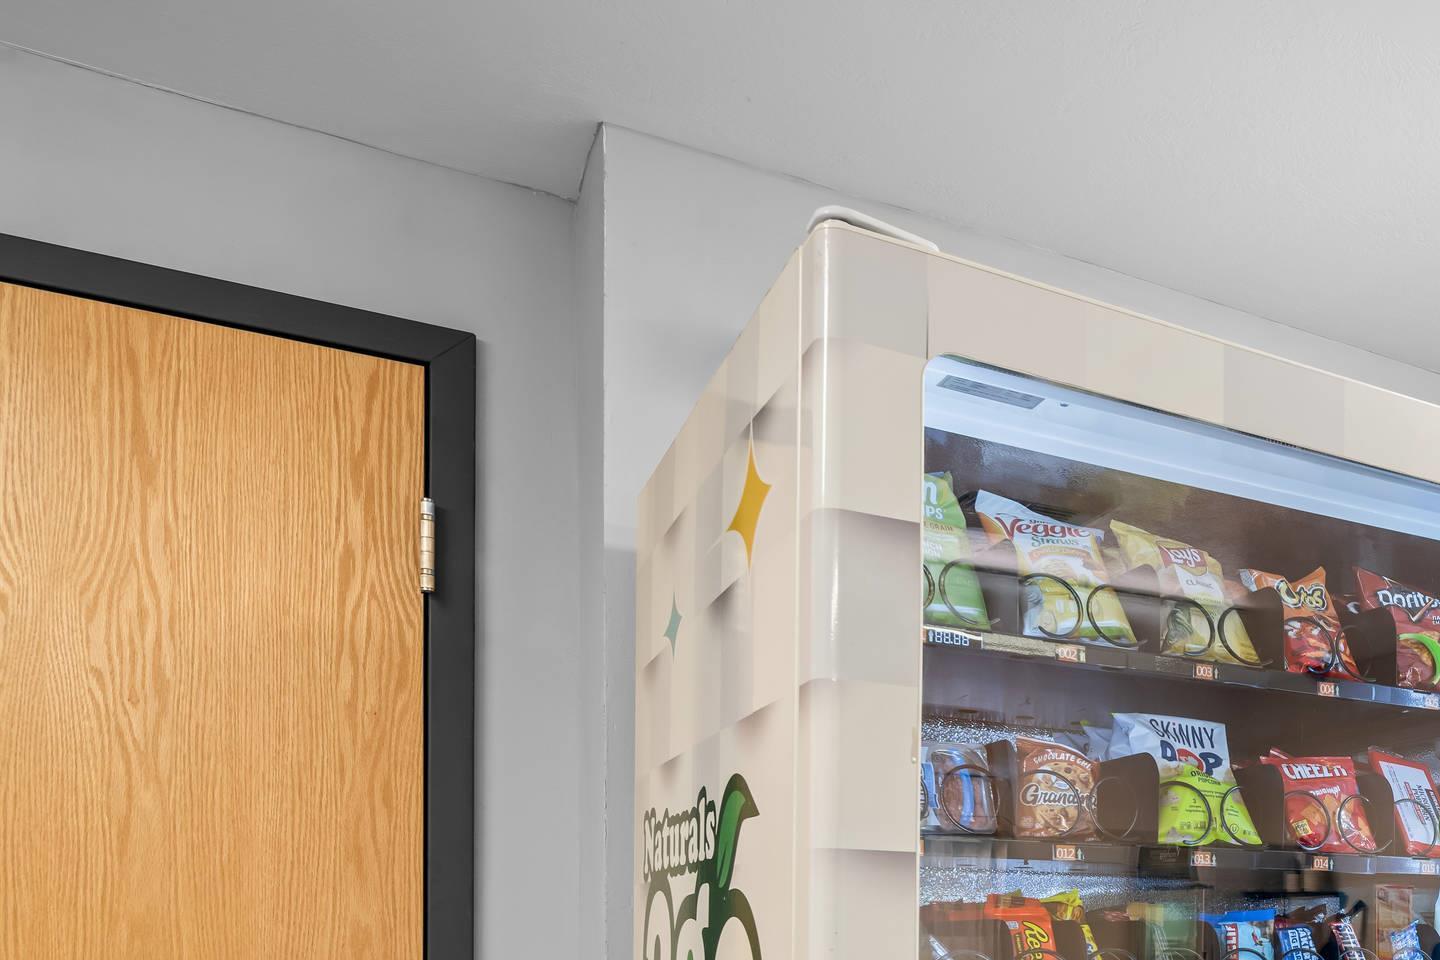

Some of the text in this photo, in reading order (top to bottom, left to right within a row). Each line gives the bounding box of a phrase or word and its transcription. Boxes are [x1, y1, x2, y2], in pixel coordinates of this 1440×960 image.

[994, 516, 1091, 541] Veggie
[1168, 548, 1201, 567] Lay's
[1196, 666, 1213, 677] 003
[643, 786, 716, 881] Naturals
[1056, 848, 1075, 858] 012
[1314, 860, 1328, 869] 014
